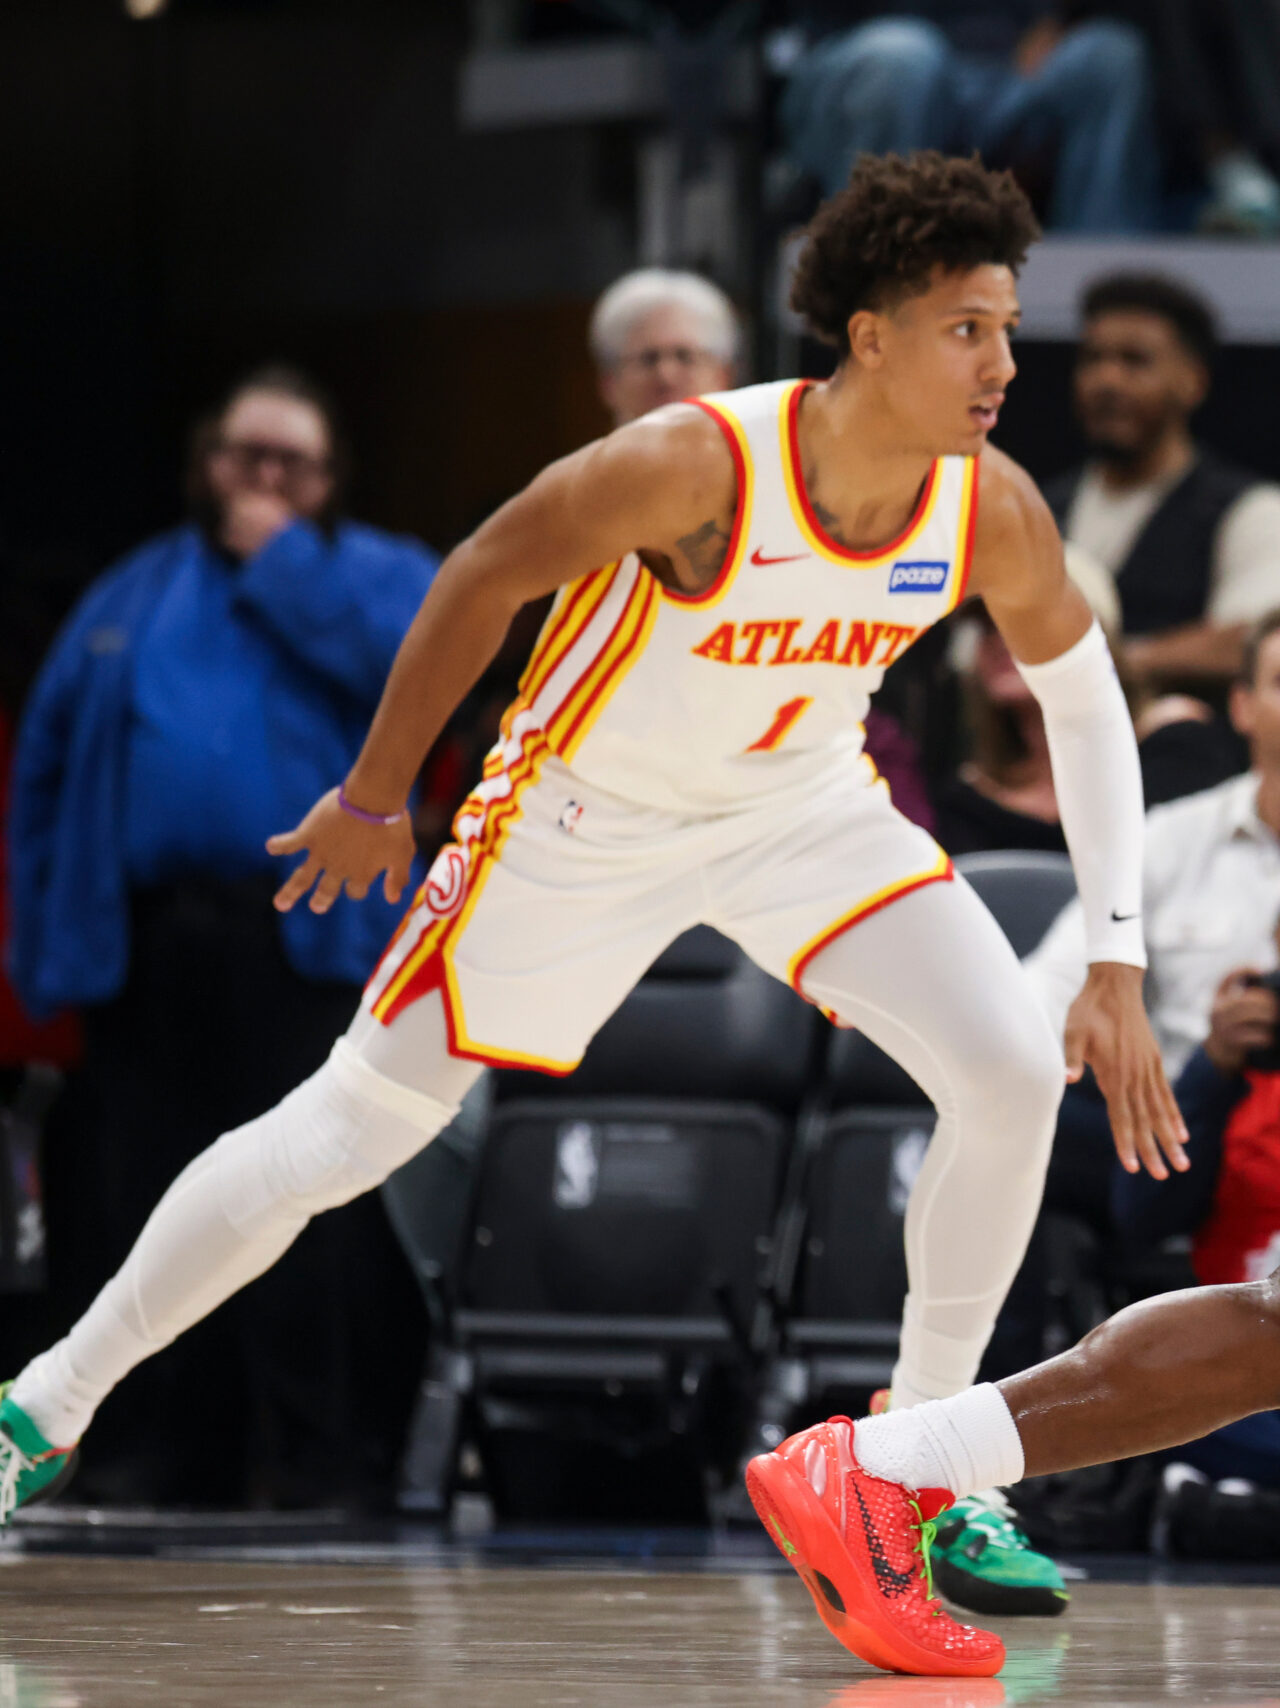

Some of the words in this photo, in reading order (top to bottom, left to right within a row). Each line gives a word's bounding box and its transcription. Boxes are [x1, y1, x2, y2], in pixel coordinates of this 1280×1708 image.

[891, 566, 945, 588] paze
[690, 619, 932, 667] ATLANT
[742, 696, 814, 753] 1
